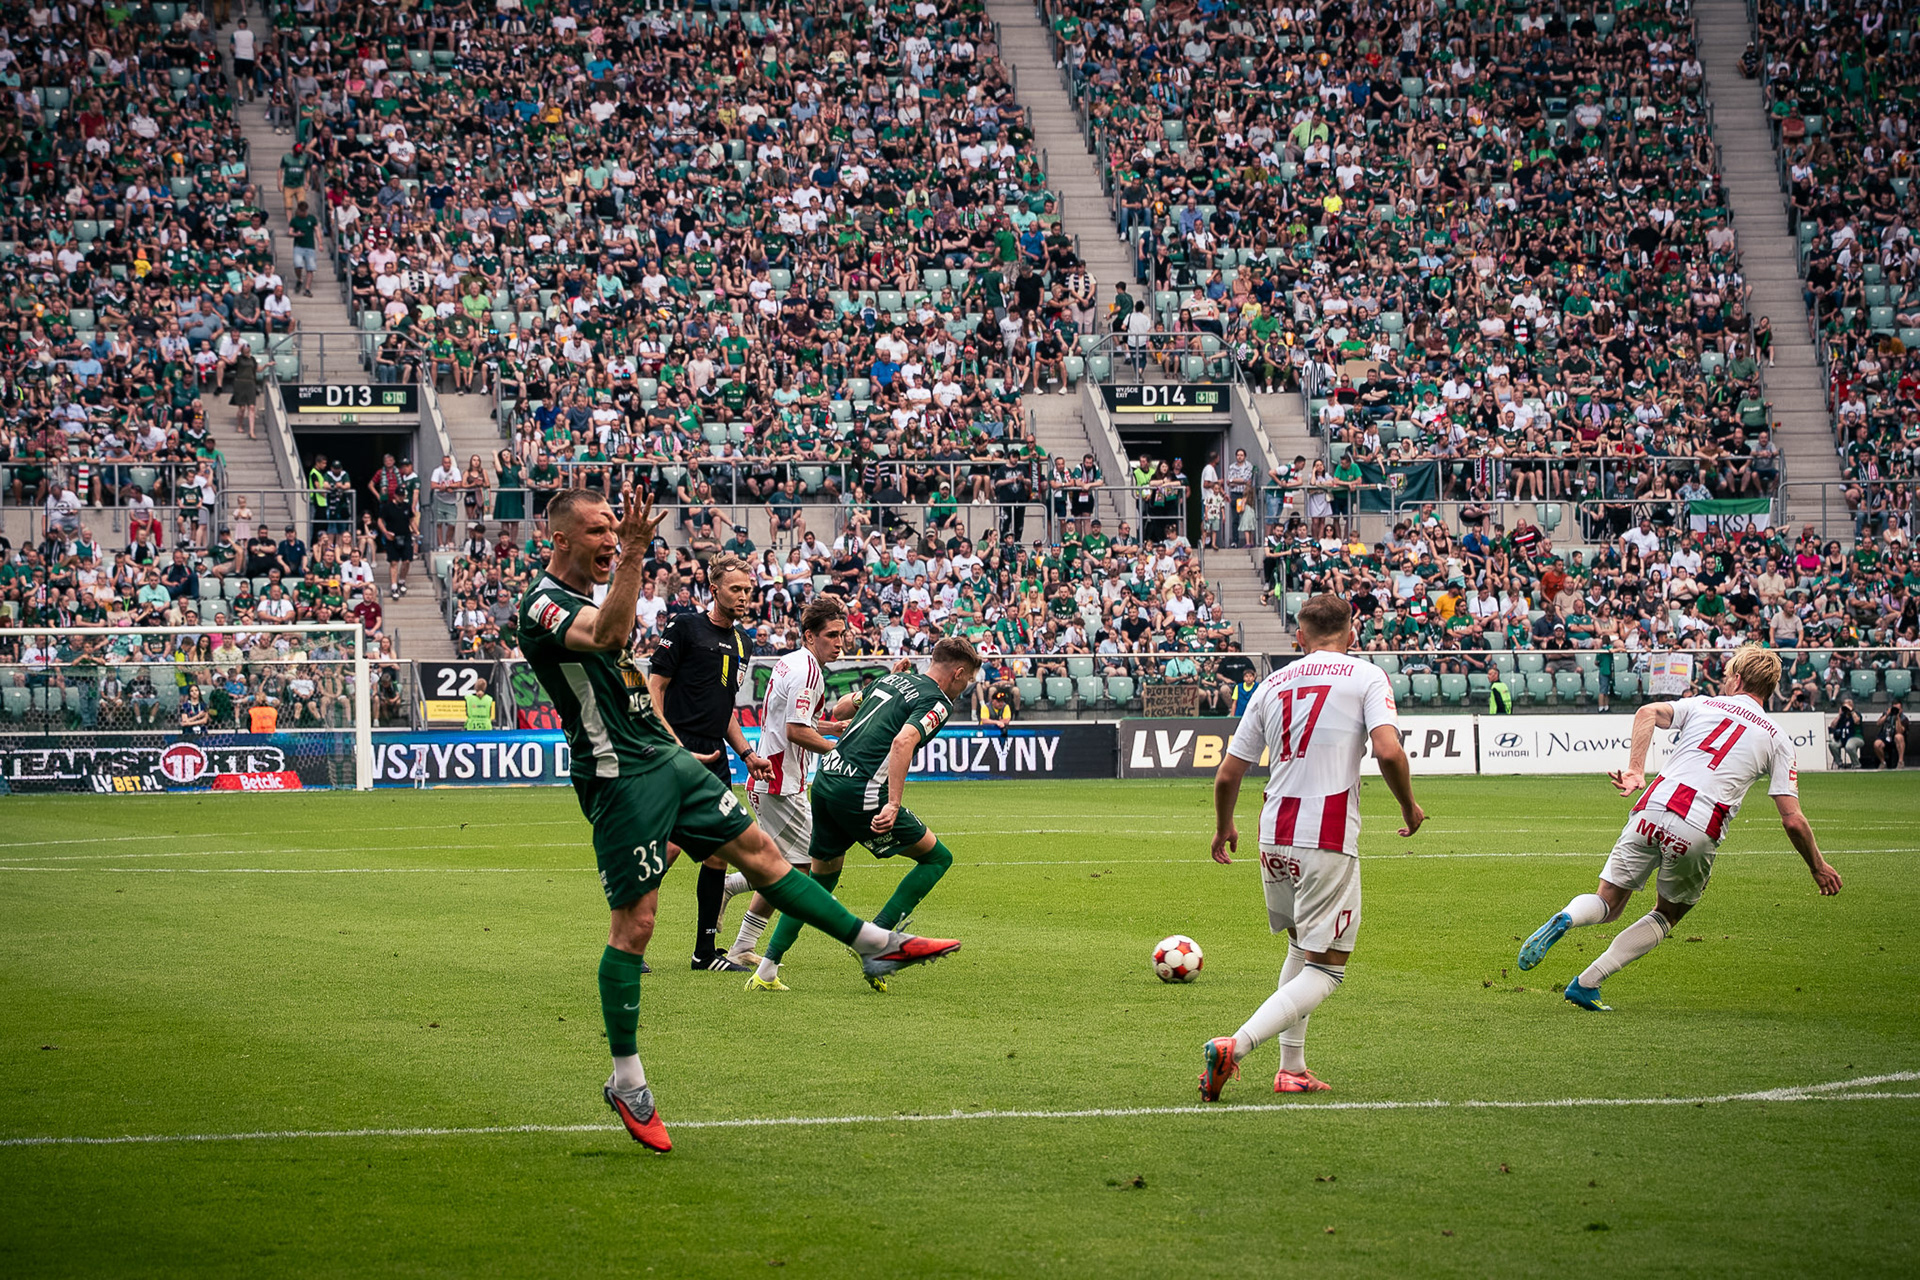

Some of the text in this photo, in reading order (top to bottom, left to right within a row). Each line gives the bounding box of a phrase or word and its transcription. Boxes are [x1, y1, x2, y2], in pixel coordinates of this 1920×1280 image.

[326, 385, 372, 406] D13
[1142, 385, 1186, 406] D14
[437, 667, 479, 696] 22
[842, 688, 893, 741] 7
[1277, 685, 1332, 762] 17
[1546, 731, 1633, 757] Nawro
[1697, 717, 1748, 772] 4
[91, 774, 163, 793] LVBET.PL
[239, 773, 285, 790] Betclic
[1636, 818, 1689, 856] Mora
[1333, 910, 1353, 940] 17
